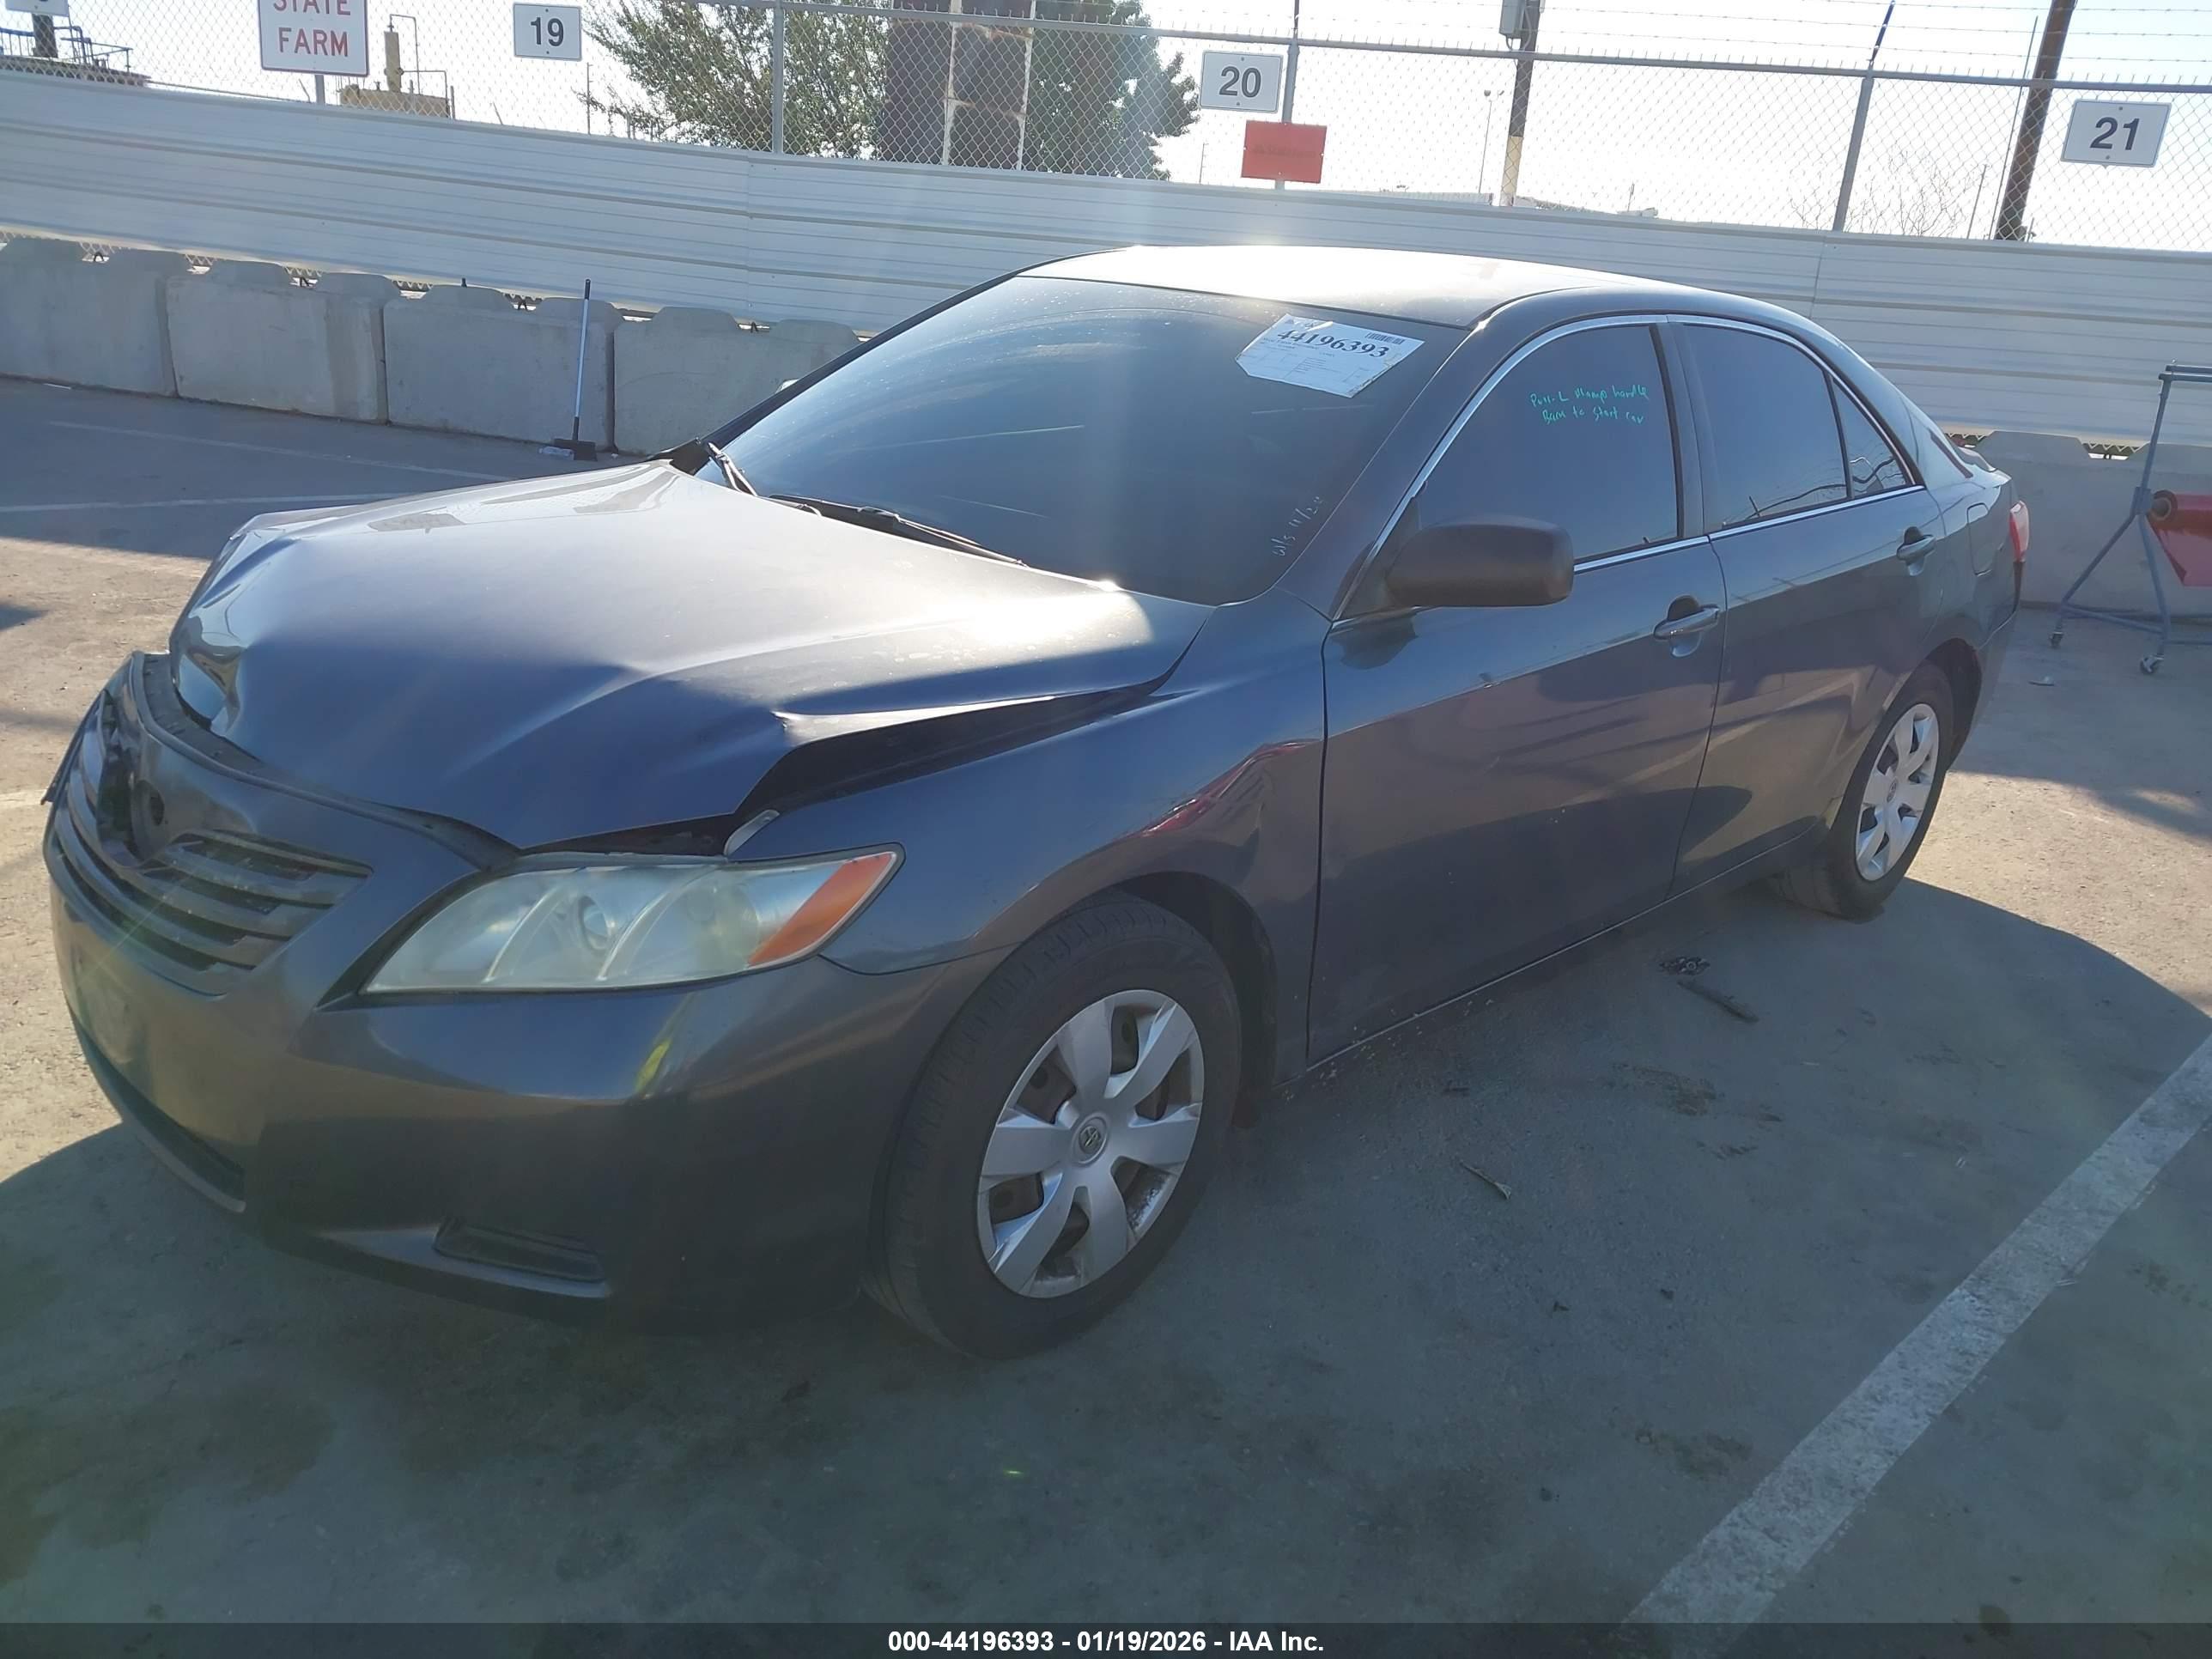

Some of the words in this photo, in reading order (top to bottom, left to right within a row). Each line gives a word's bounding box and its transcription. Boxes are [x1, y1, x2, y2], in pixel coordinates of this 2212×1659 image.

[278, 27, 349, 57] FARM
[531, 17, 564, 46] 19
[1218, 66, 1261, 98] 20
[2089, 117, 2140, 150] 21
[1277, 330, 1390, 357] 44196393
